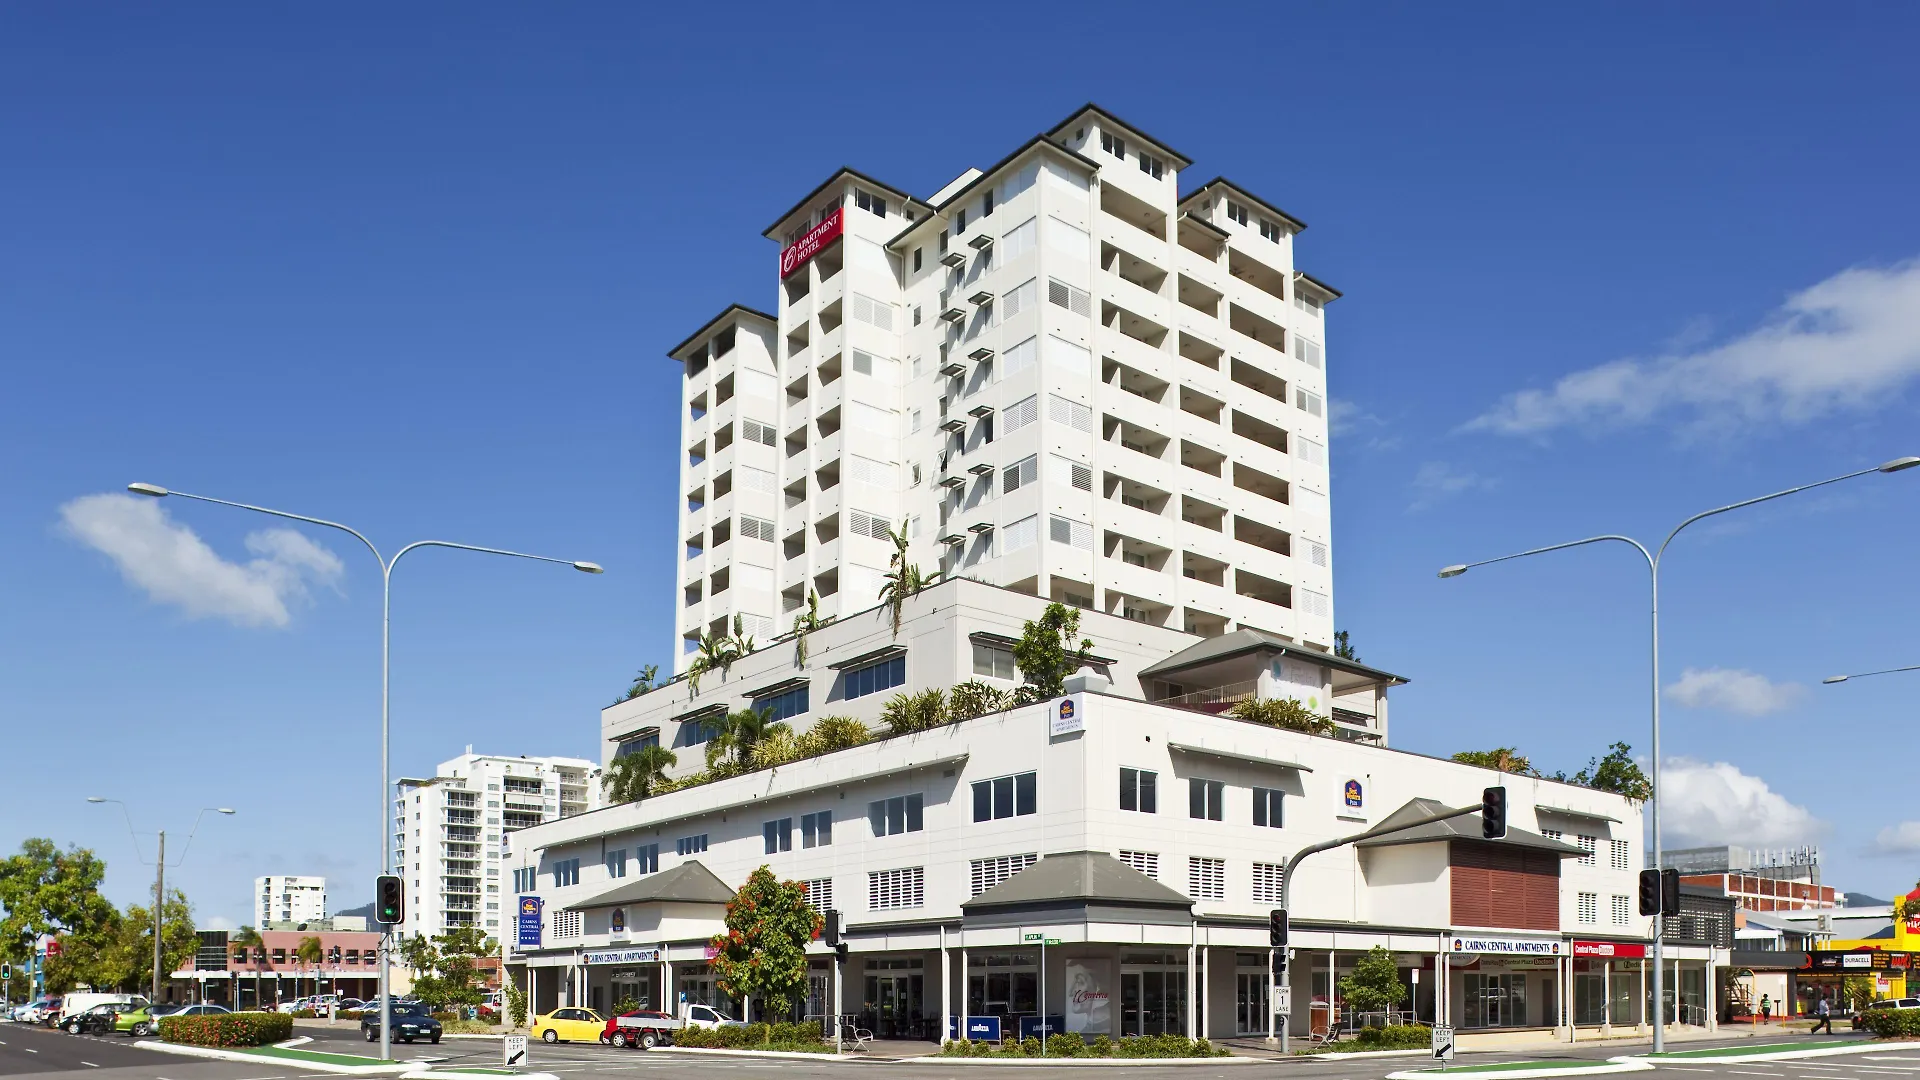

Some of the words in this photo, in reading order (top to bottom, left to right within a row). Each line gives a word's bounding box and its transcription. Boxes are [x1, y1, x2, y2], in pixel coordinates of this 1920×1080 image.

[797, 214, 838, 251] APARTMENT
[797, 239, 820, 261] HOTEL
[1465, 940, 1487, 951] CAIRNS
[1488, 941, 1514, 952] CENTRAL
[1515, 942, 1550, 953] APARTMENTS
[589, 954, 604, 963] CAIRNS
[604, 953, 623, 963] CENTRAL
[624, 951, 653, 962] APARTMENTS
[1280, 996, 1284, 1005] 1
